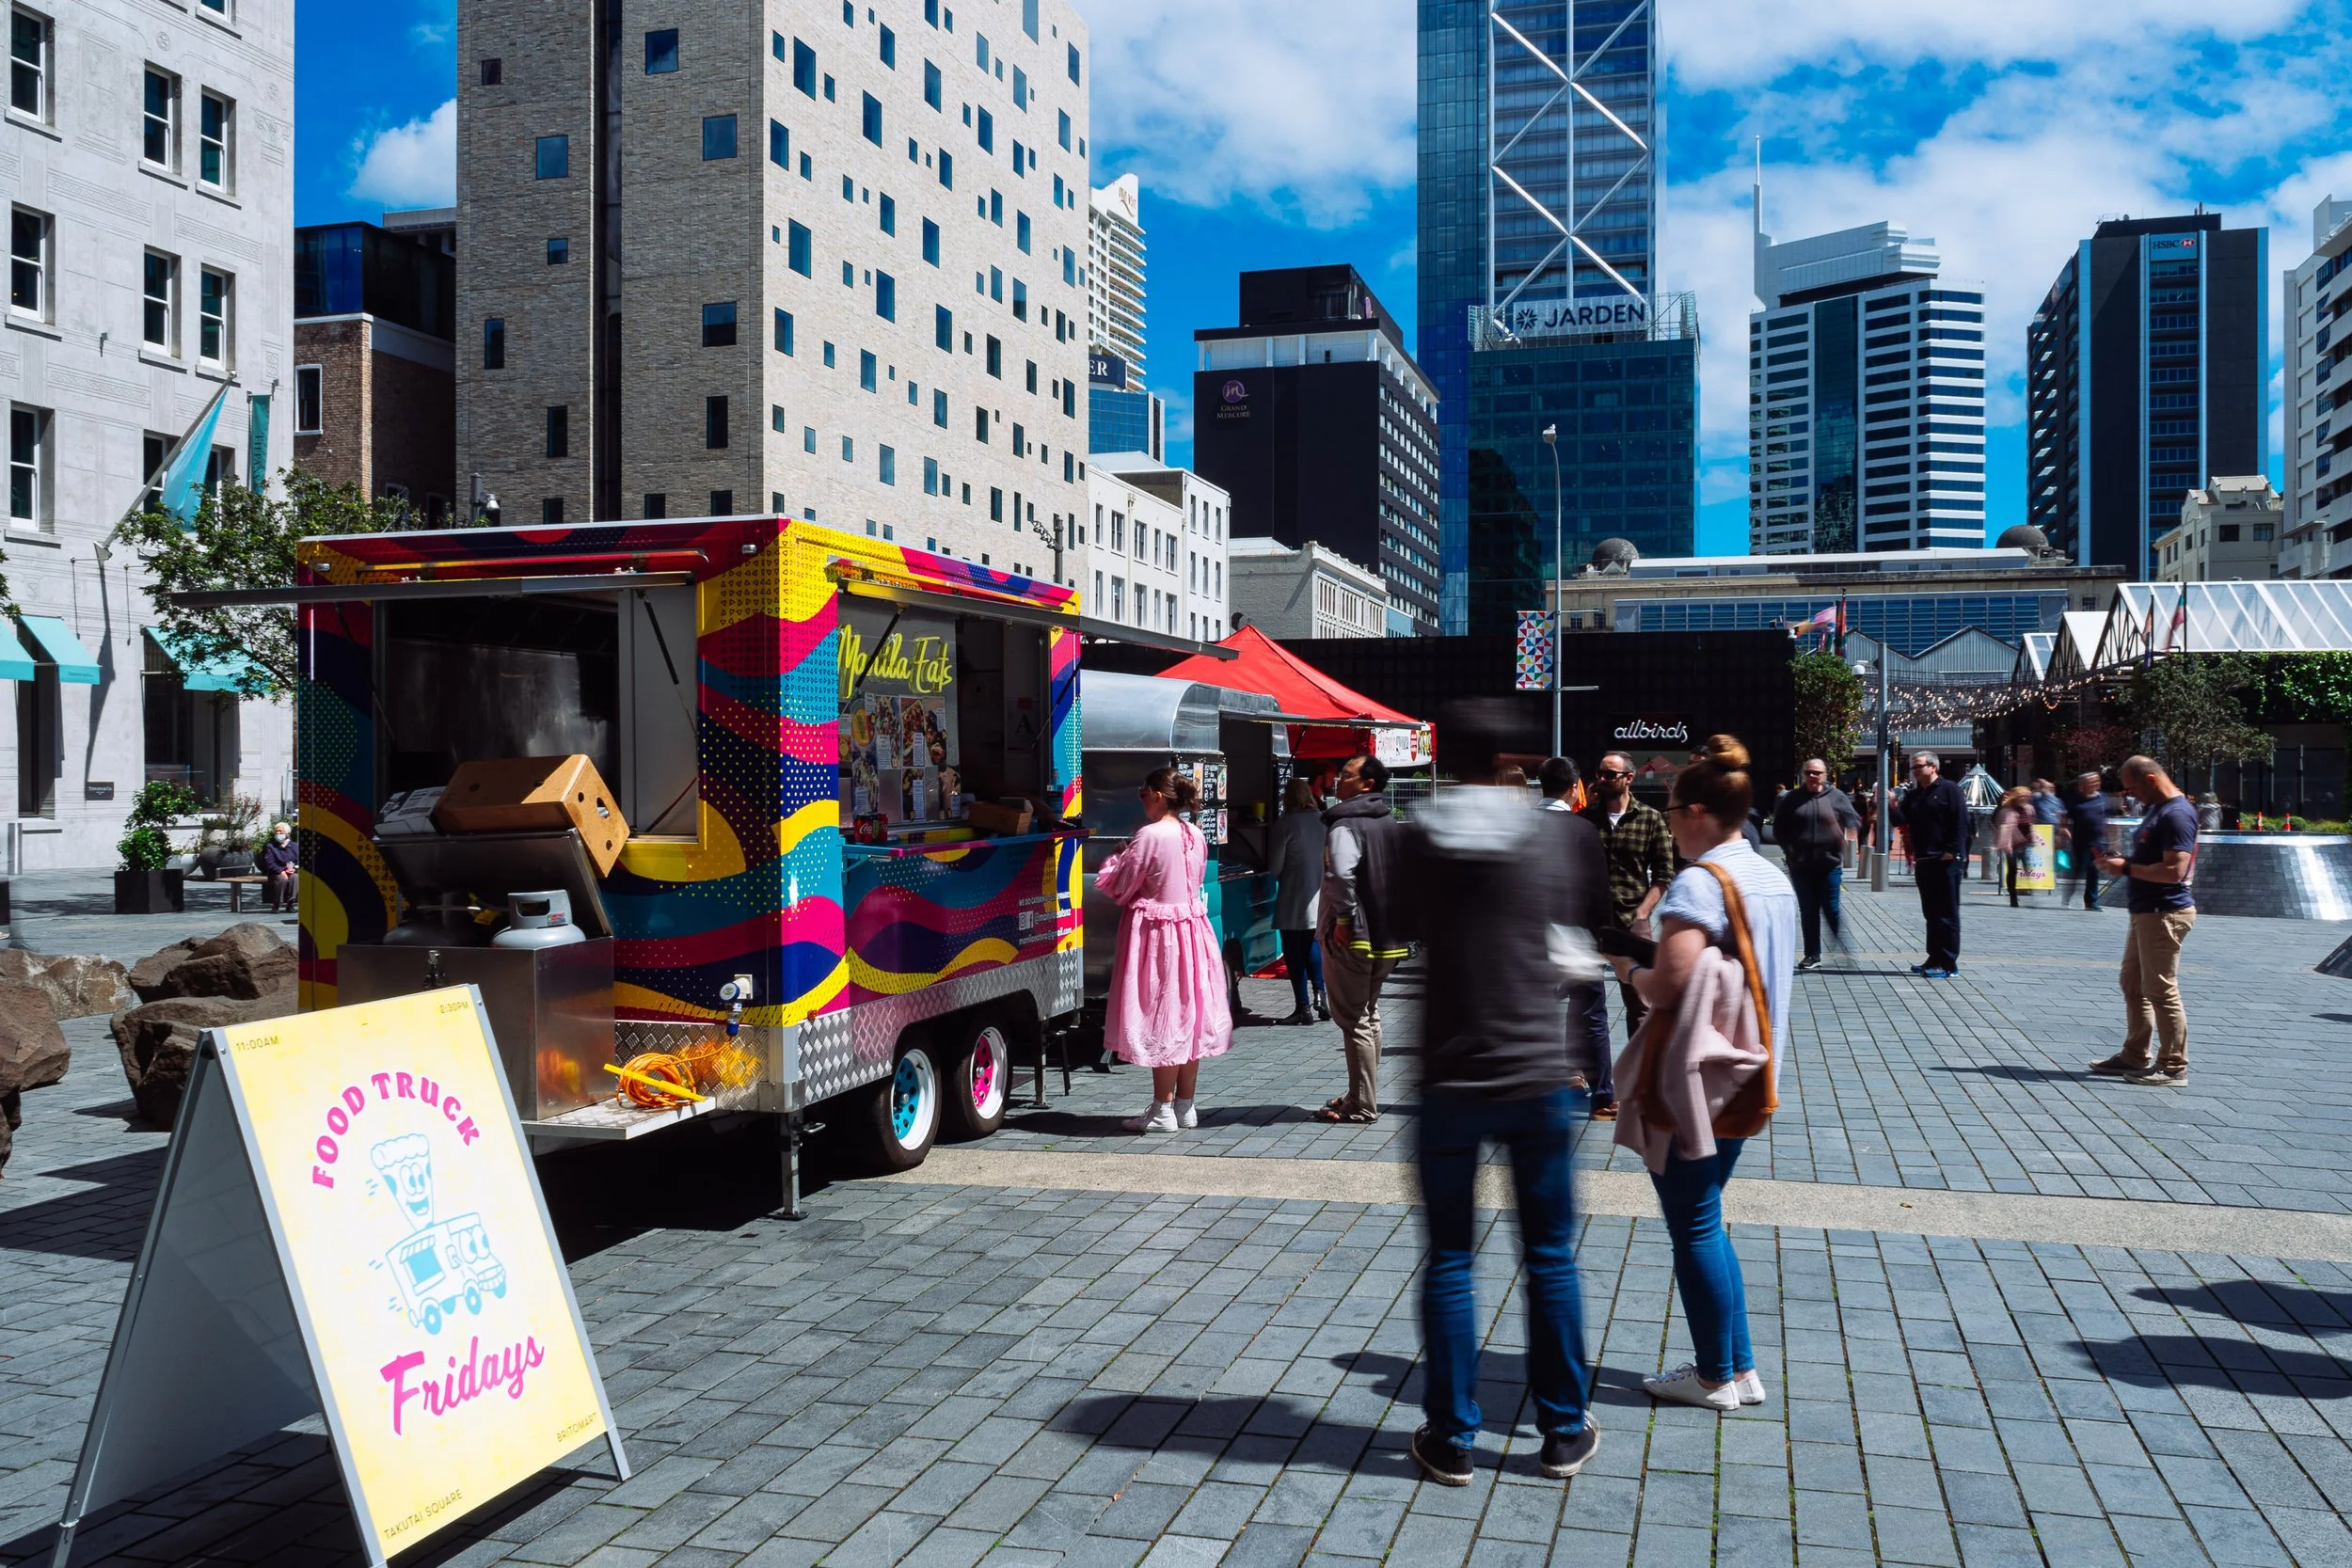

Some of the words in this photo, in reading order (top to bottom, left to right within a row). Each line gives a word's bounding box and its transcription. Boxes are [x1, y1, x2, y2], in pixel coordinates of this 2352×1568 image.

[2153, 240, 2180, 249] HSBC
[1545, 303, 1645, 328] JARDEN
[1216, 411, 1251, 420] MERCURE
[837, 625, 911, 698] Manila
[912, 635, 953, 693] Eats
[1015, 712, 1035, 735] A
[1613, 720, 1689, 743] allbirds
[439, 1001, 469, 1014] 2:30PM
[236, 1036, 279, 1053] 11:00AM
[312, 1086, 365, 1189] FOOD
[371, 1071, 480, 1147] TRUCK
[380, 1336, 545, 1435] Fridays
[556, 1412, 596, 1443] BRITOMART
[383, 1511, 424, 1540] TAKUTAI
[425, 1489, 464, 1517] SQUARE
